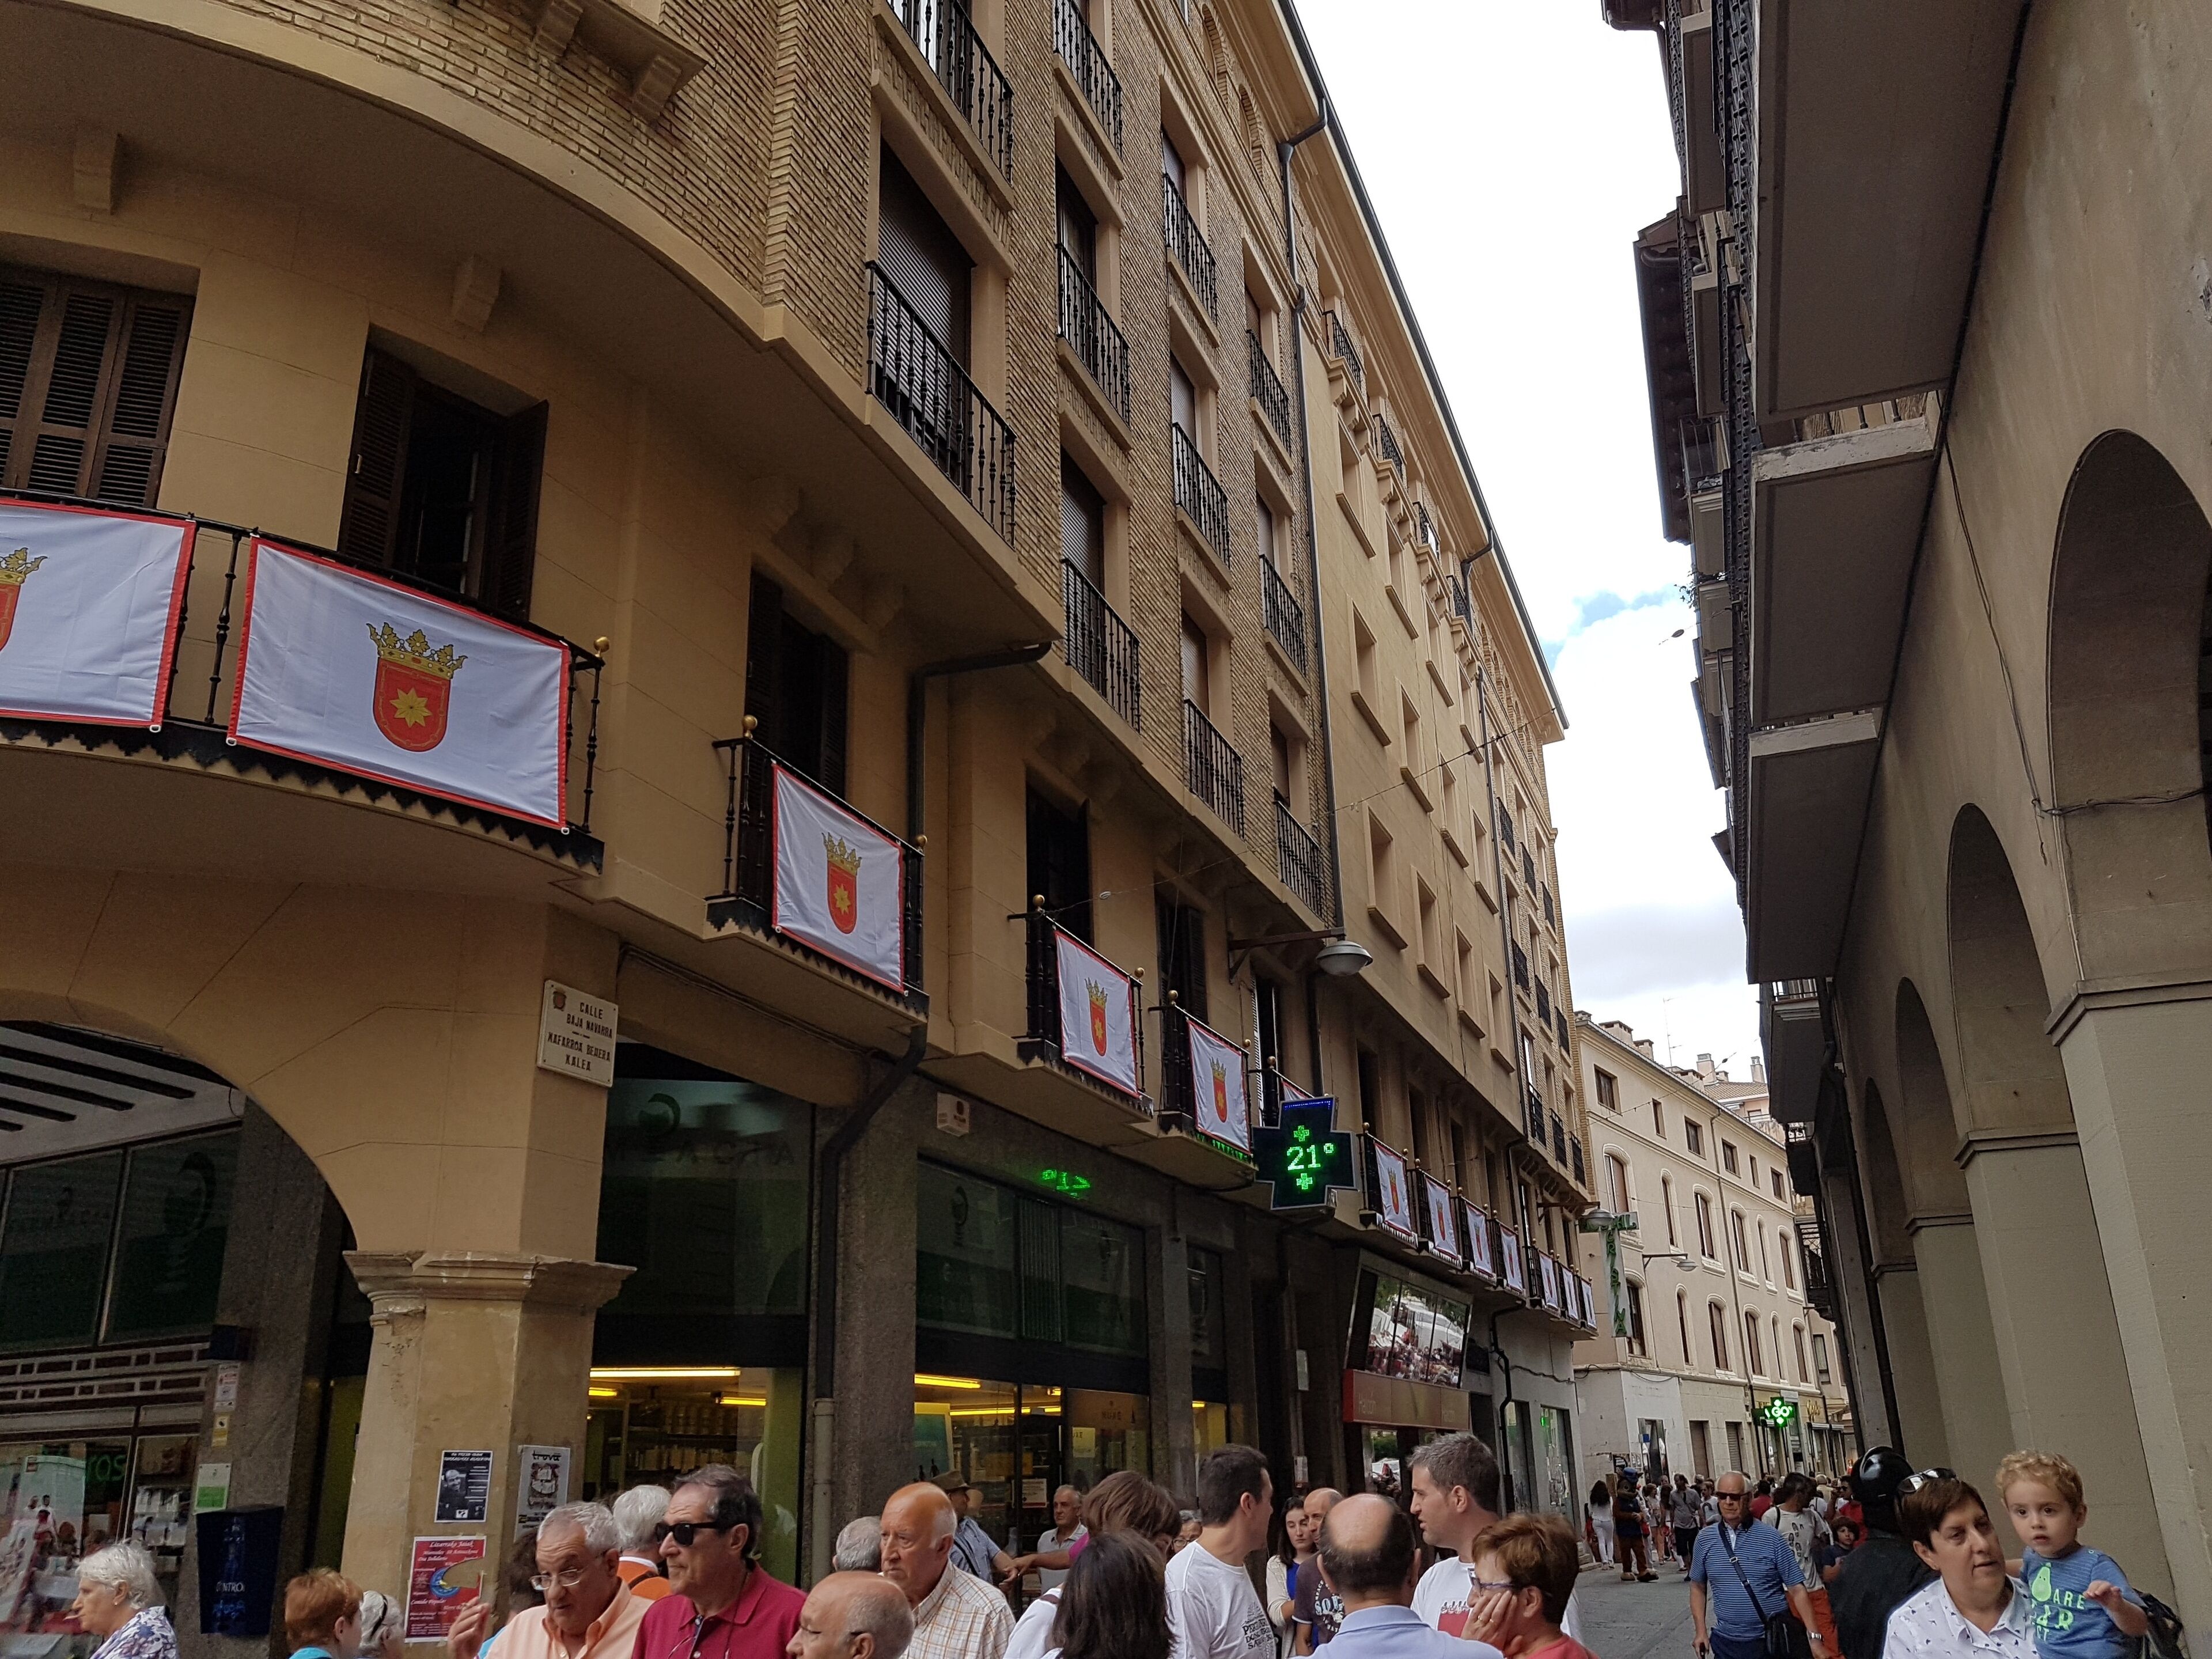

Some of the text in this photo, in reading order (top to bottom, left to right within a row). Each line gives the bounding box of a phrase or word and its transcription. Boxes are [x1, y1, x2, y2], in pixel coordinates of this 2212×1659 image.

[579, 1002, 603, 1020] CALLE
[566, 1013, 612, 1039] BAJA NAVARRA
[547, 1032, 611, 1062] NAFARROA BEHERA
[565, 1054, 592, 1071] KALEA
[1605, 1230, 1627, 1335] CRISTINA
[2053, 1589, 2086, 1610] ARE
